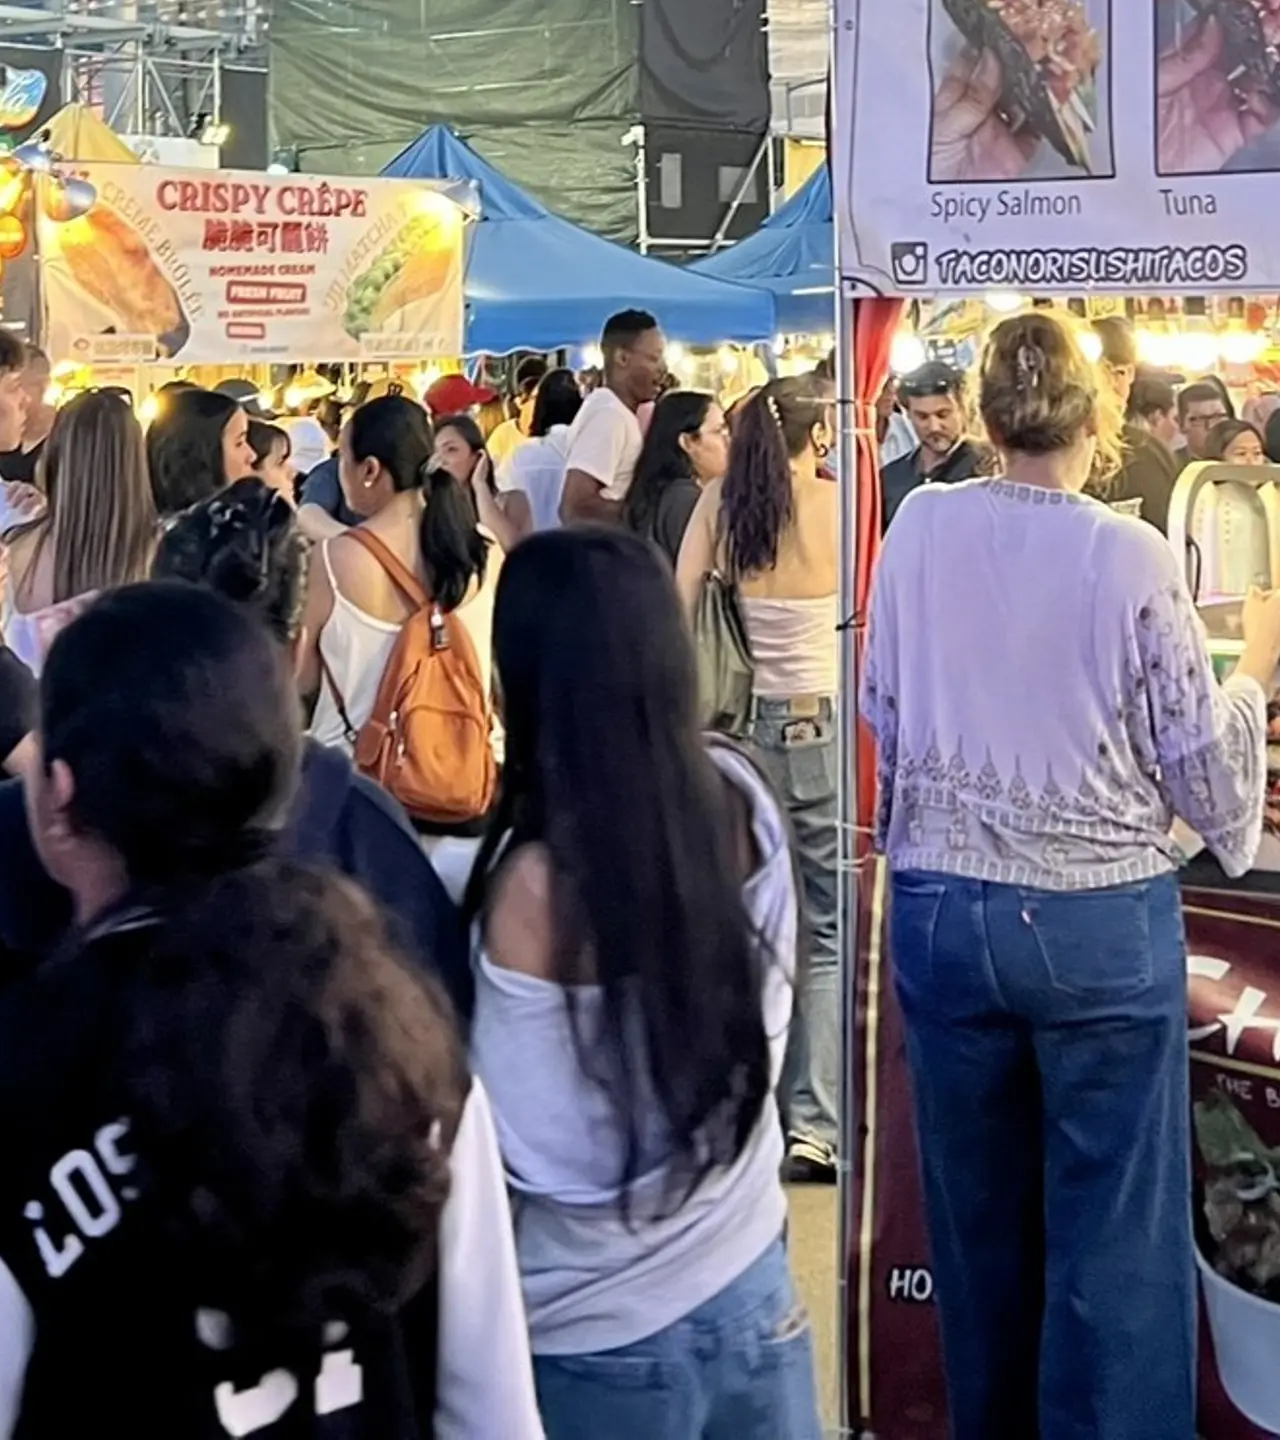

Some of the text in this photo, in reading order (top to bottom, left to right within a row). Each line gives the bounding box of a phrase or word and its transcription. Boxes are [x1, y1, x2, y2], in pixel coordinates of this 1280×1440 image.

[156, 180, 270, 217] CRISPY
[276, 180, 368, 218] CRÊPE
[930, 188, 1081, 222] Spicy Salmon
[1158, 189, 1217, 216] Tuna
[934, 244, 1248, 286] TACONORISUSHITACOS
[889, 1267, 934, 1301] HO
